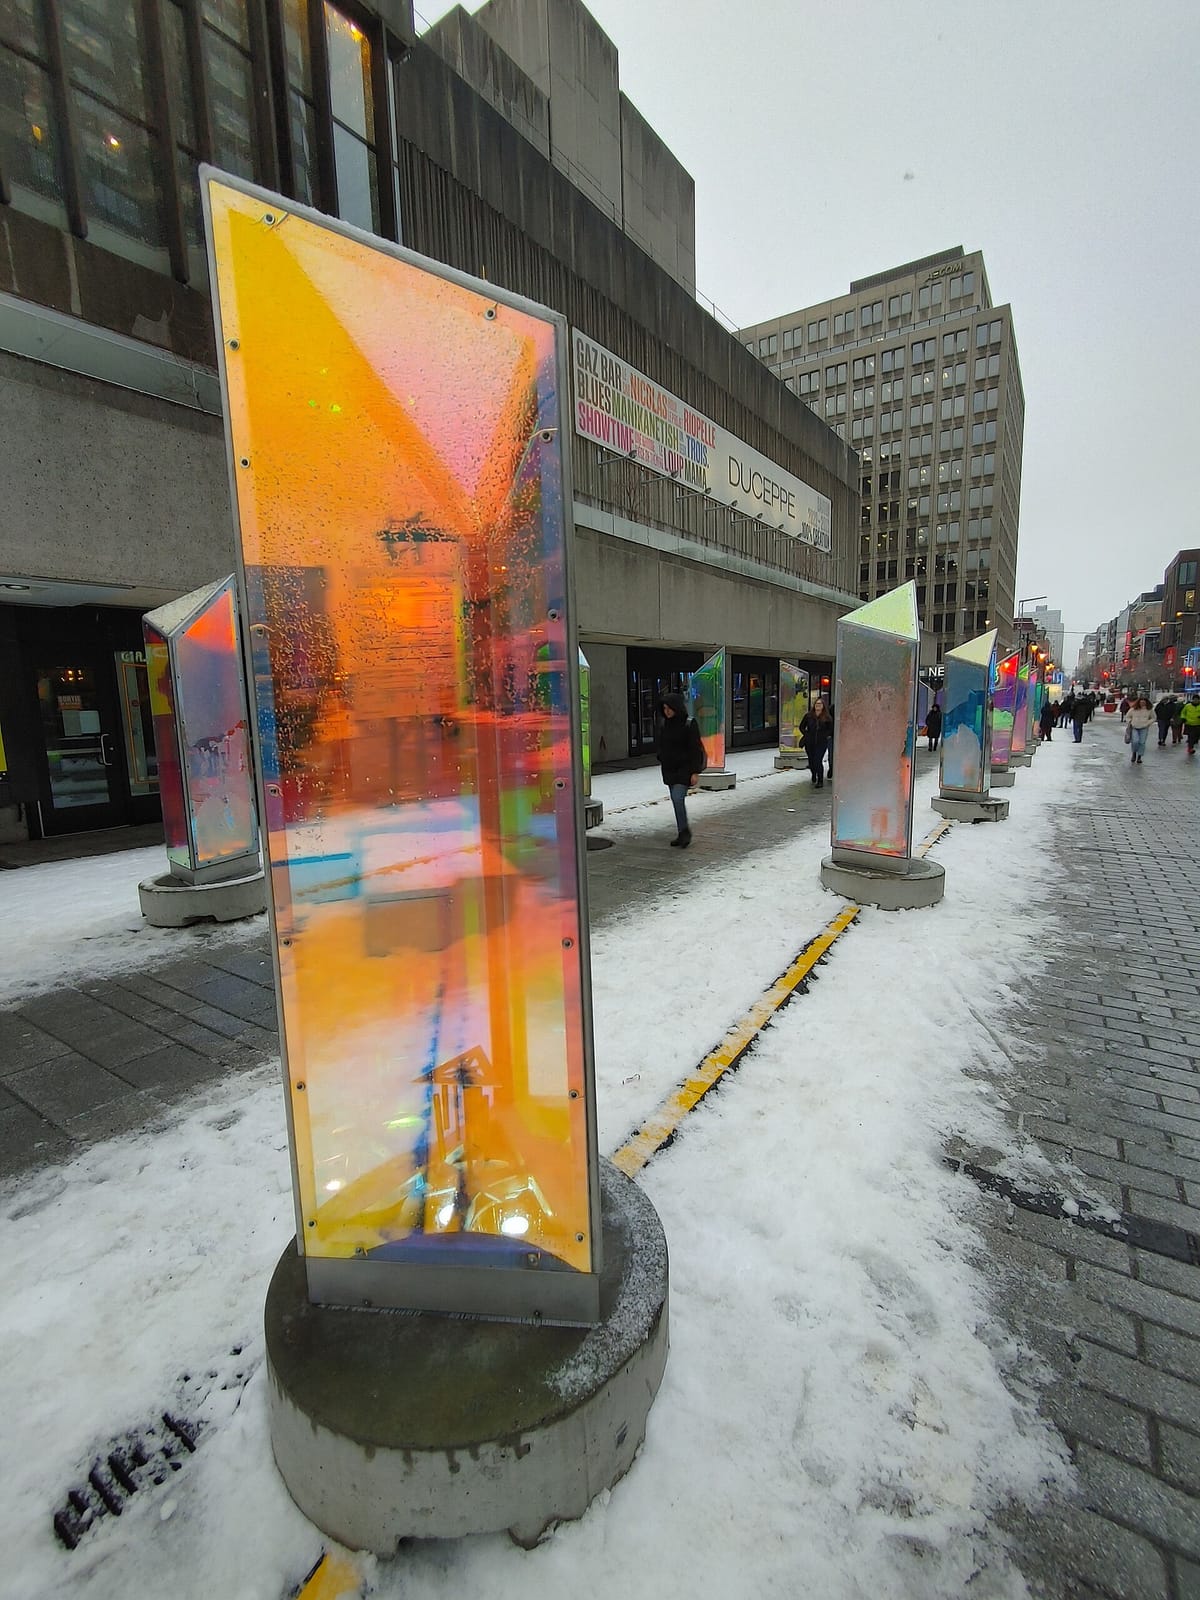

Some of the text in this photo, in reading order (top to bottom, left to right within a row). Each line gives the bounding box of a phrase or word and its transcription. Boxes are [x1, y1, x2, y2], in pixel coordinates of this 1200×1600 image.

[926, 261, 964, 282] AECOM
[576, 337, 598, 376] GAZ
[602, 355, 622, 392] BAR
[577, 369, 611, 414] BLUES
[630, 373, 668, 419] NICOLAS
[578, 401, 635, 453] SHOWTIME
[612, 389, 679, 451] MANIKANETISH
[684, 408, 716, 449] RIOPELLE
[664, 449, 685, 478] LOUP
[684, 461, 707, 490] MAMA
[728, 455, 796, 519] DUCEPPE
